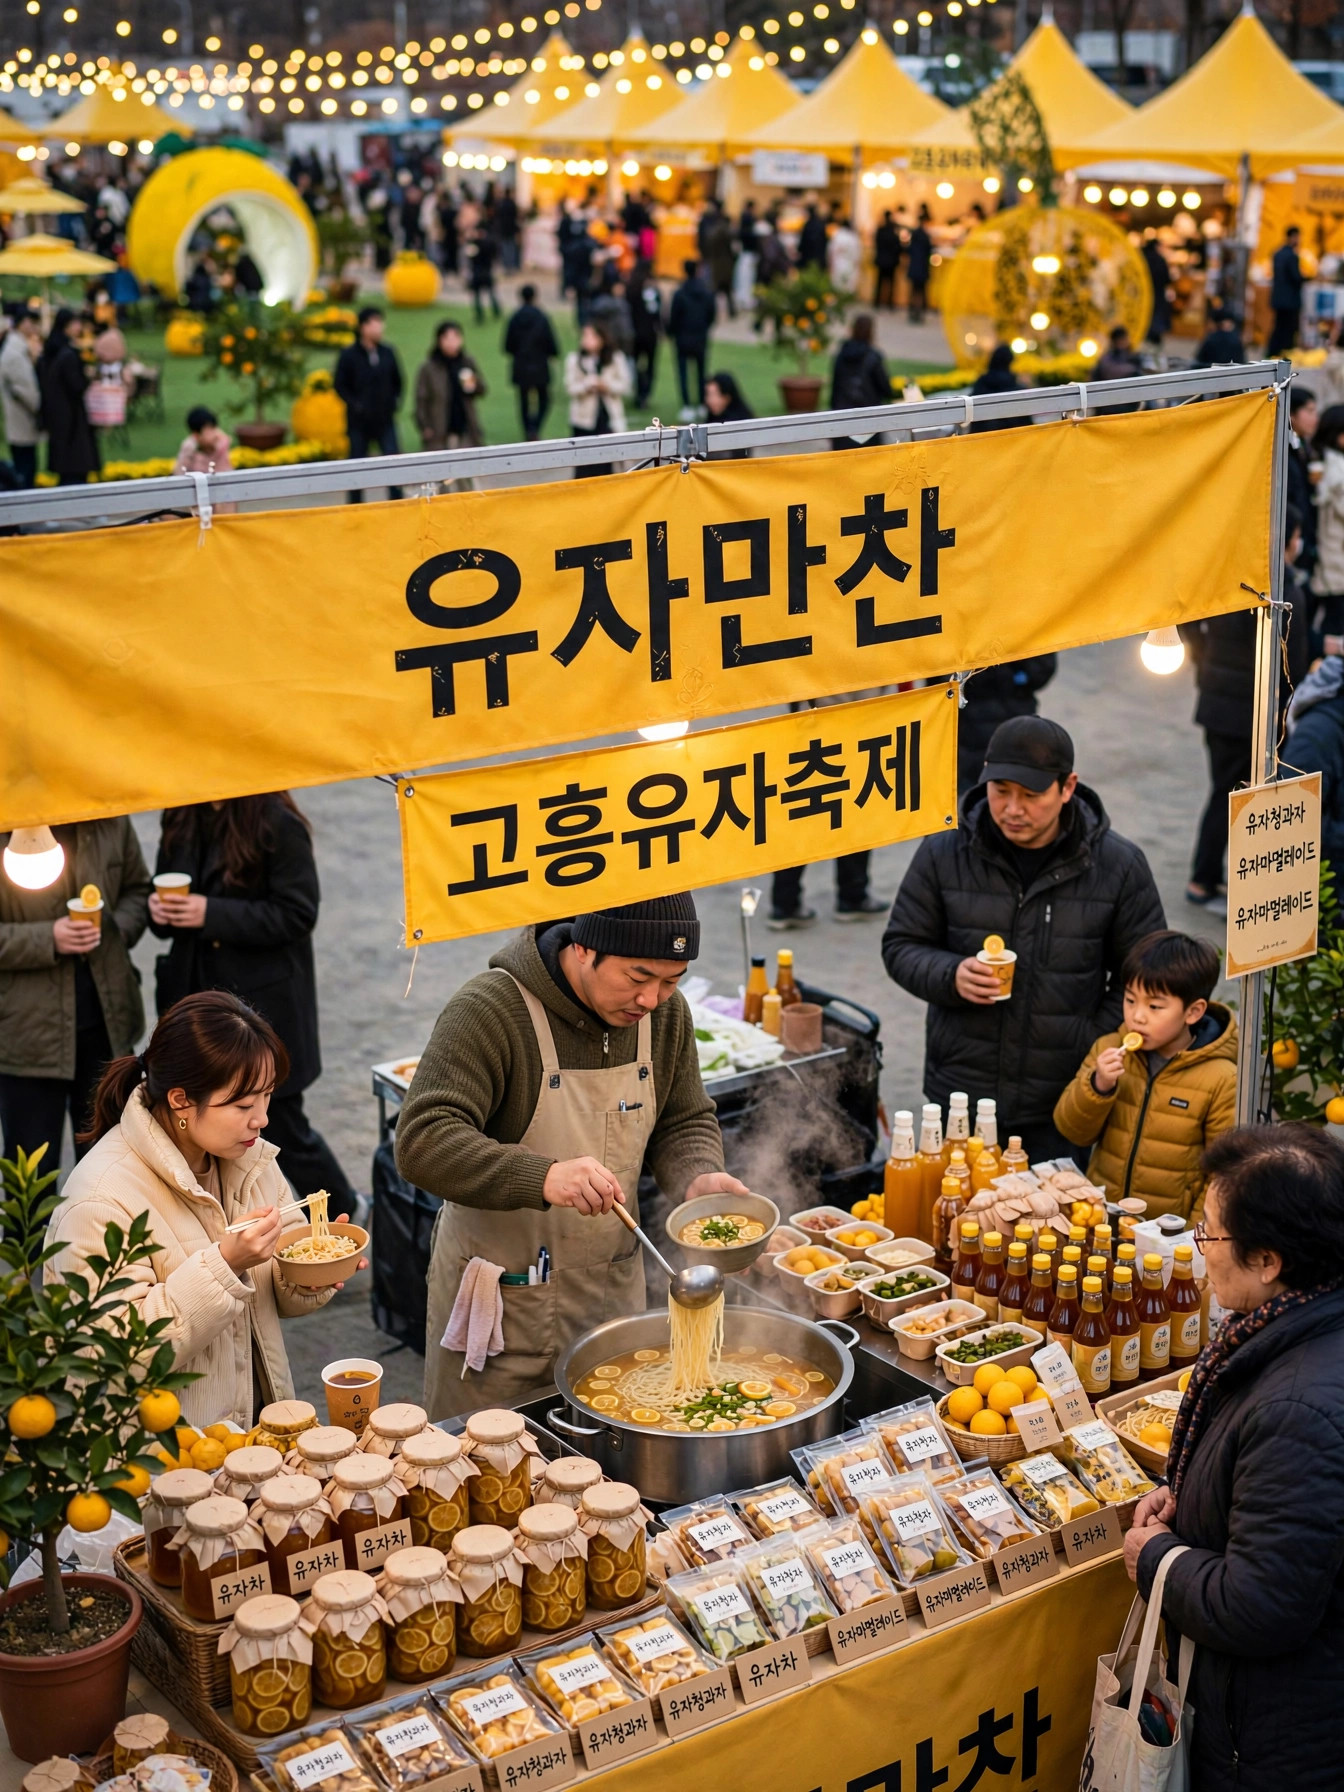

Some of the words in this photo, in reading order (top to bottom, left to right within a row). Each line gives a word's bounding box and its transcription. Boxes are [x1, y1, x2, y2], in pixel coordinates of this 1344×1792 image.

[395, 487, 955, 718] 유자만찬
[448, 721, 921, 896] 고흥유자축제
[1246, 801, 1306, 835] 유자청과자
[1237, 842, 1316, 880] 유자마멀레이드
[1235, 891, 1314, 930] 유자마멀레이드
[361, 1529, 407, 1559] 유자차
[1072, 1523, 1107, 1551] 유자차
[293, 1551, 339, 1581] 유자차
[1002, 1546, 1049, 1580] 유자청과자
[218, 1574, 265, 1605] 유자차
[749, 1651, 798, 1687] 유자차
[669, 1682, 727, 1720] 유자청과자
[588, 1714, 648, 1753] 유자청과자
[505, 1747, 567, 1788] 유자청과자
